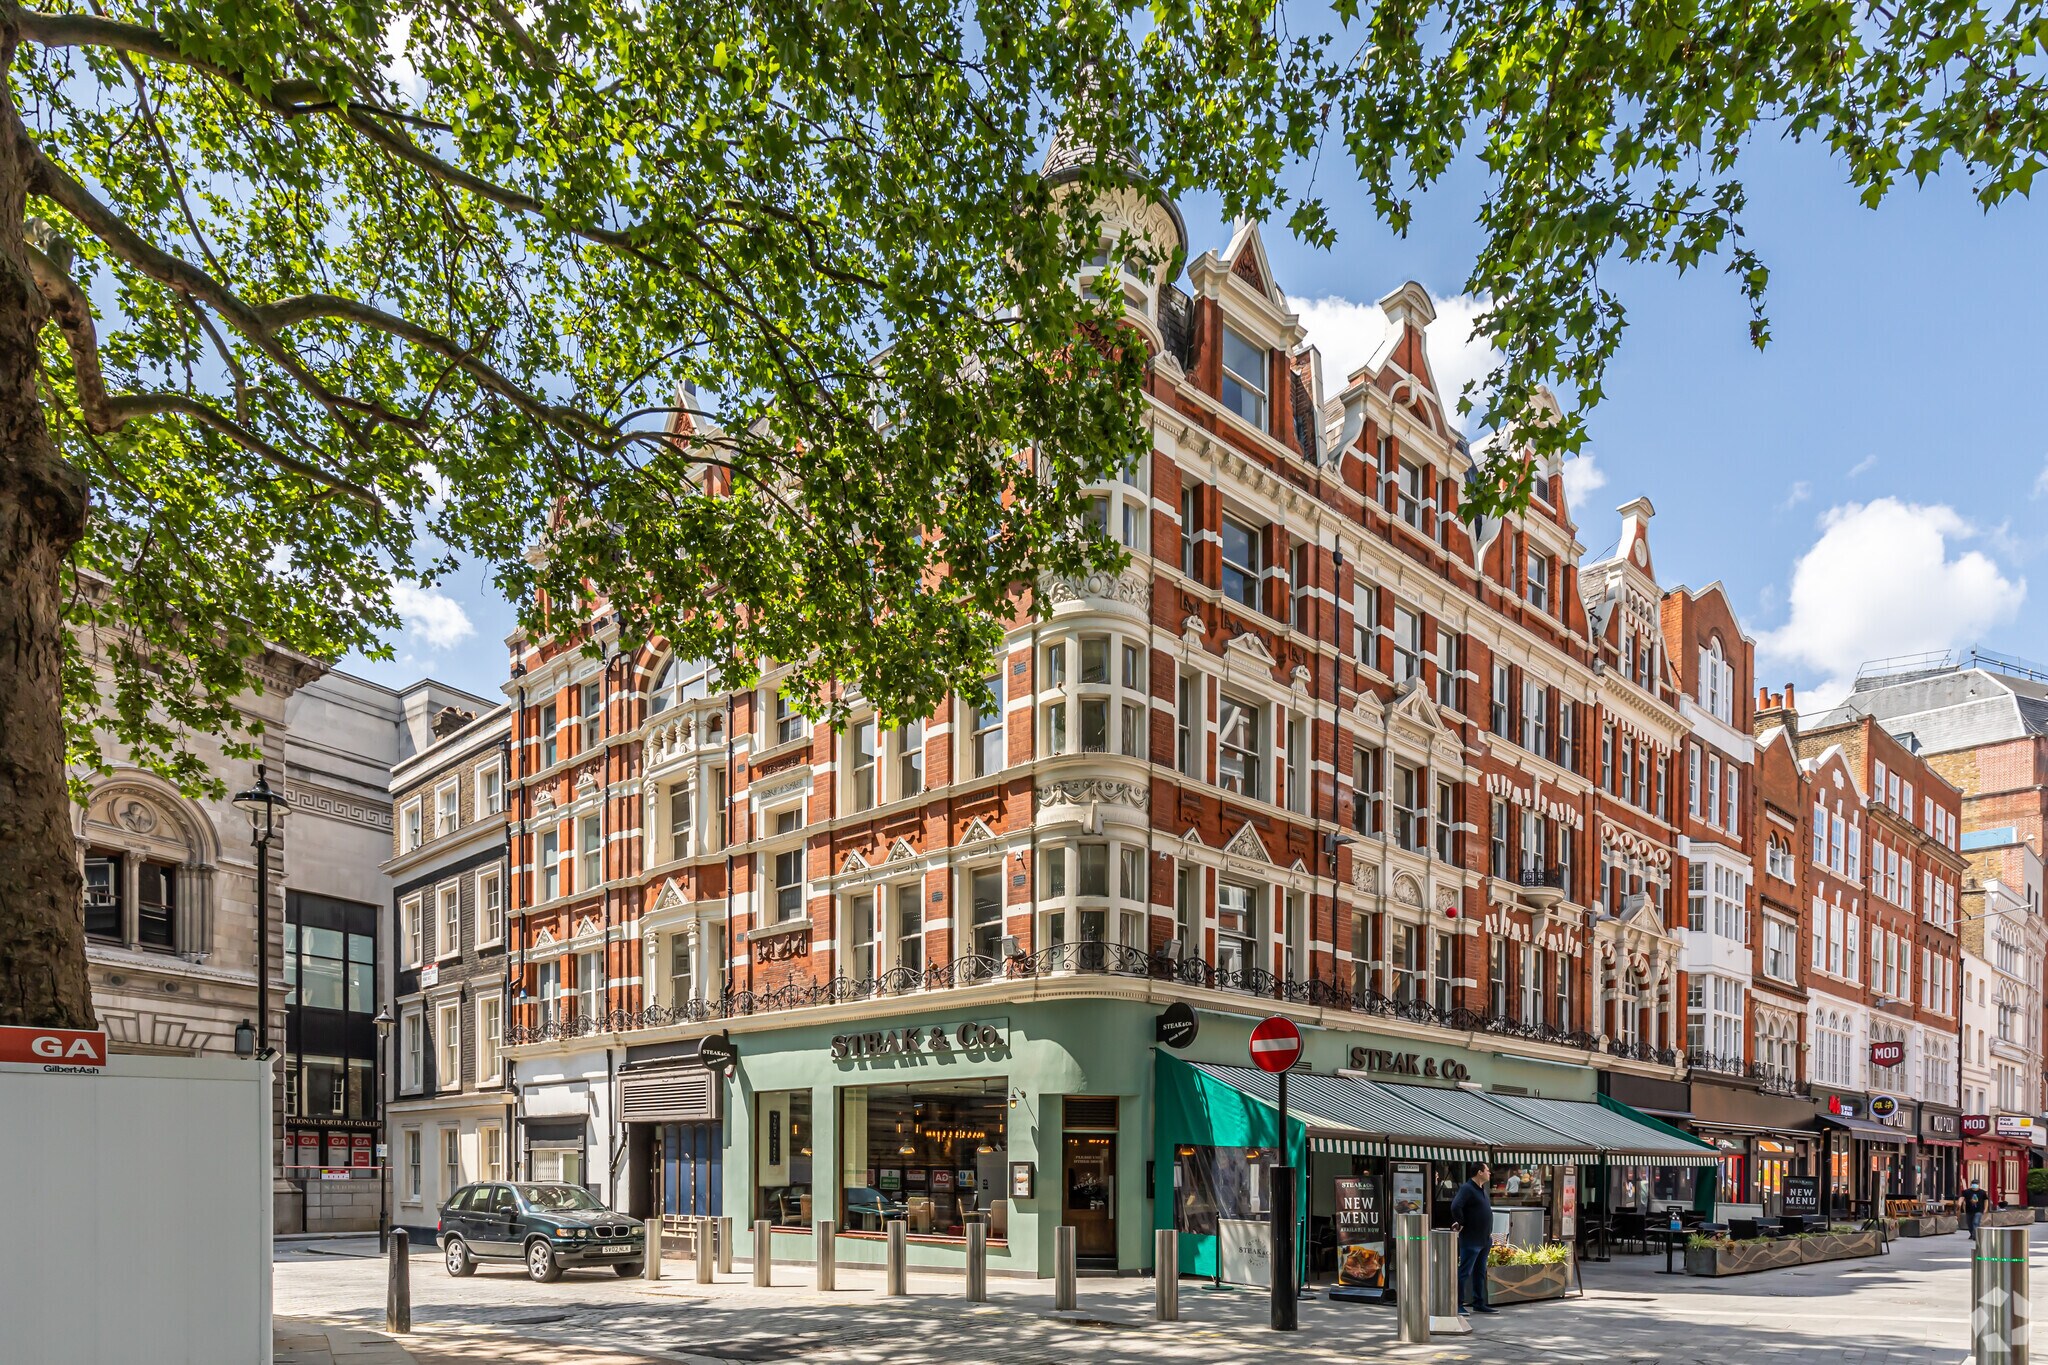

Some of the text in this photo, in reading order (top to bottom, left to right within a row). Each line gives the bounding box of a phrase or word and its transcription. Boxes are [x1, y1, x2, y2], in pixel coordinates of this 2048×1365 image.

[31, 1036, 99, 1060] GA
[831, 1027, 922, 1059] STEAK
[927, 1026, 951, 1051] &
[1875, 1046, 1899, 1060] MOD
[1350, 1046, 1421, 1075] STEAK
[1423, 1057, 1440, 1077] &
[43, 1065, 99, 1075] Gilbert-Ash
[1963, 1119, 1986, 1130] MOD
[301, 1137, 317, 1145] GA
[1790, 1188, 1813, 1197] NEW
[1344, 1197, 1374, 1210] NEW
[1786, 1196, 1816, 1206] MENU
[1340, 1211, 1379, 1225] MENU
